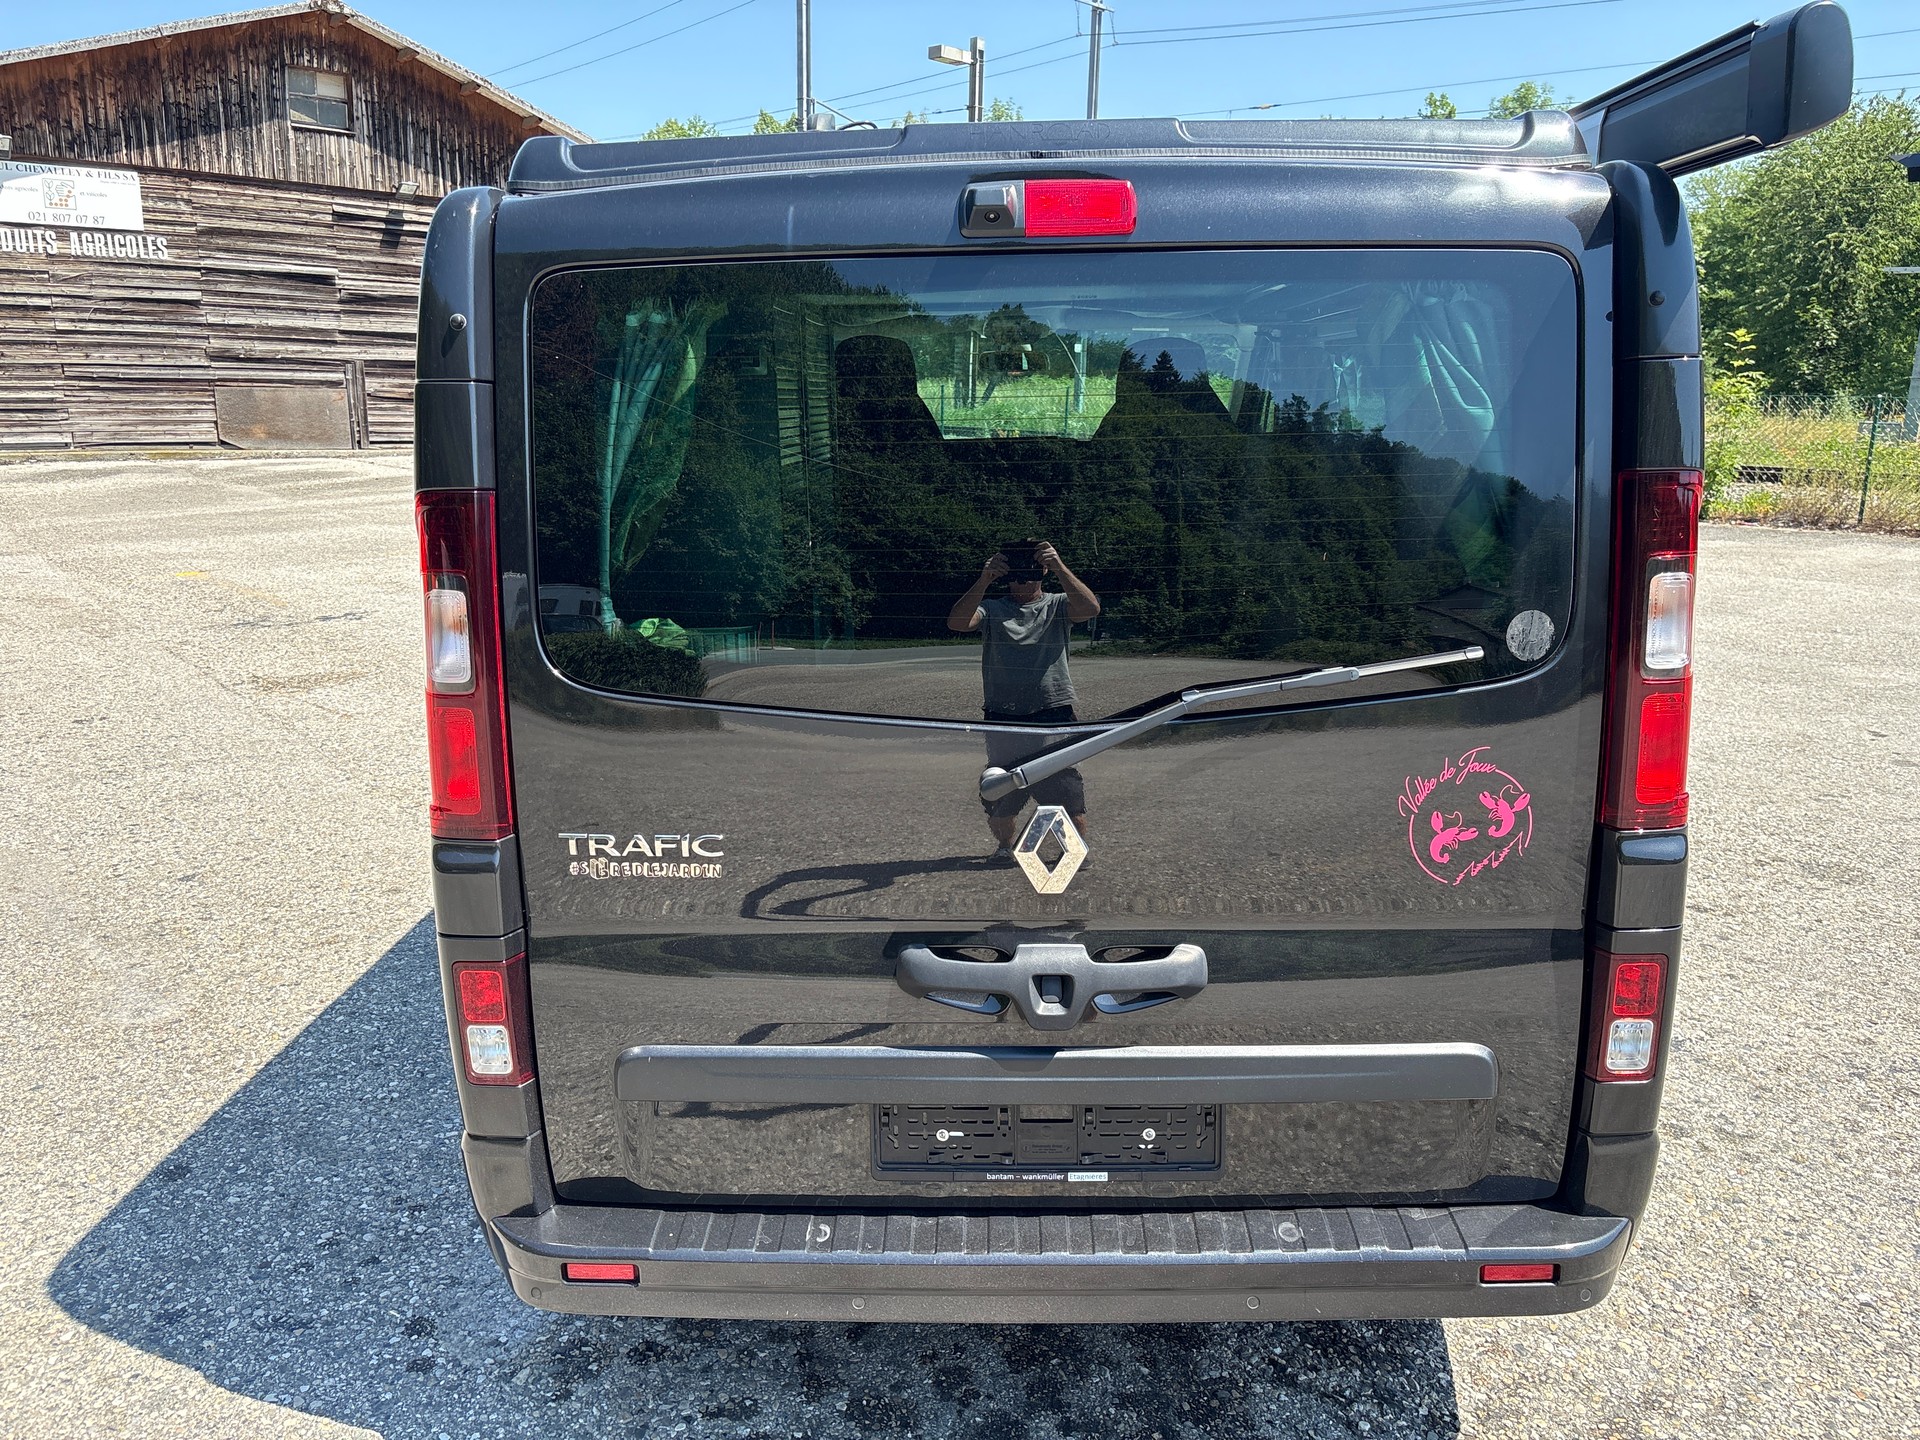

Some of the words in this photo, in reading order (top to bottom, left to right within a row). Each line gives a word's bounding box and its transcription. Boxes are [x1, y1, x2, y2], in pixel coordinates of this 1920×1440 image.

[969, 122, 1111, 141] HANROAD
[16, 163, 82, 177] CHEVALLEY
[97, 171, 120, 180] FILS
[122, 173, 136, 182] SA
[28, 211, 47, 222] 021
[52, 213, 71, 223] 807
[75, 214, 88, 224] 07
[93, 215, 105, 225] 87
[69, 232, 169, 260] AGRICOLES
[1398, 775, 1437, 817] Vallée
[1439, 757, 1457, 783] de
[1456, 746, 1497, 785] Joux
[558, 833, 725, 857] TRAFIC
[986, 1172, 1014, 1180] bantam
[1022, 1172, 1065, 1180] wankmüller
